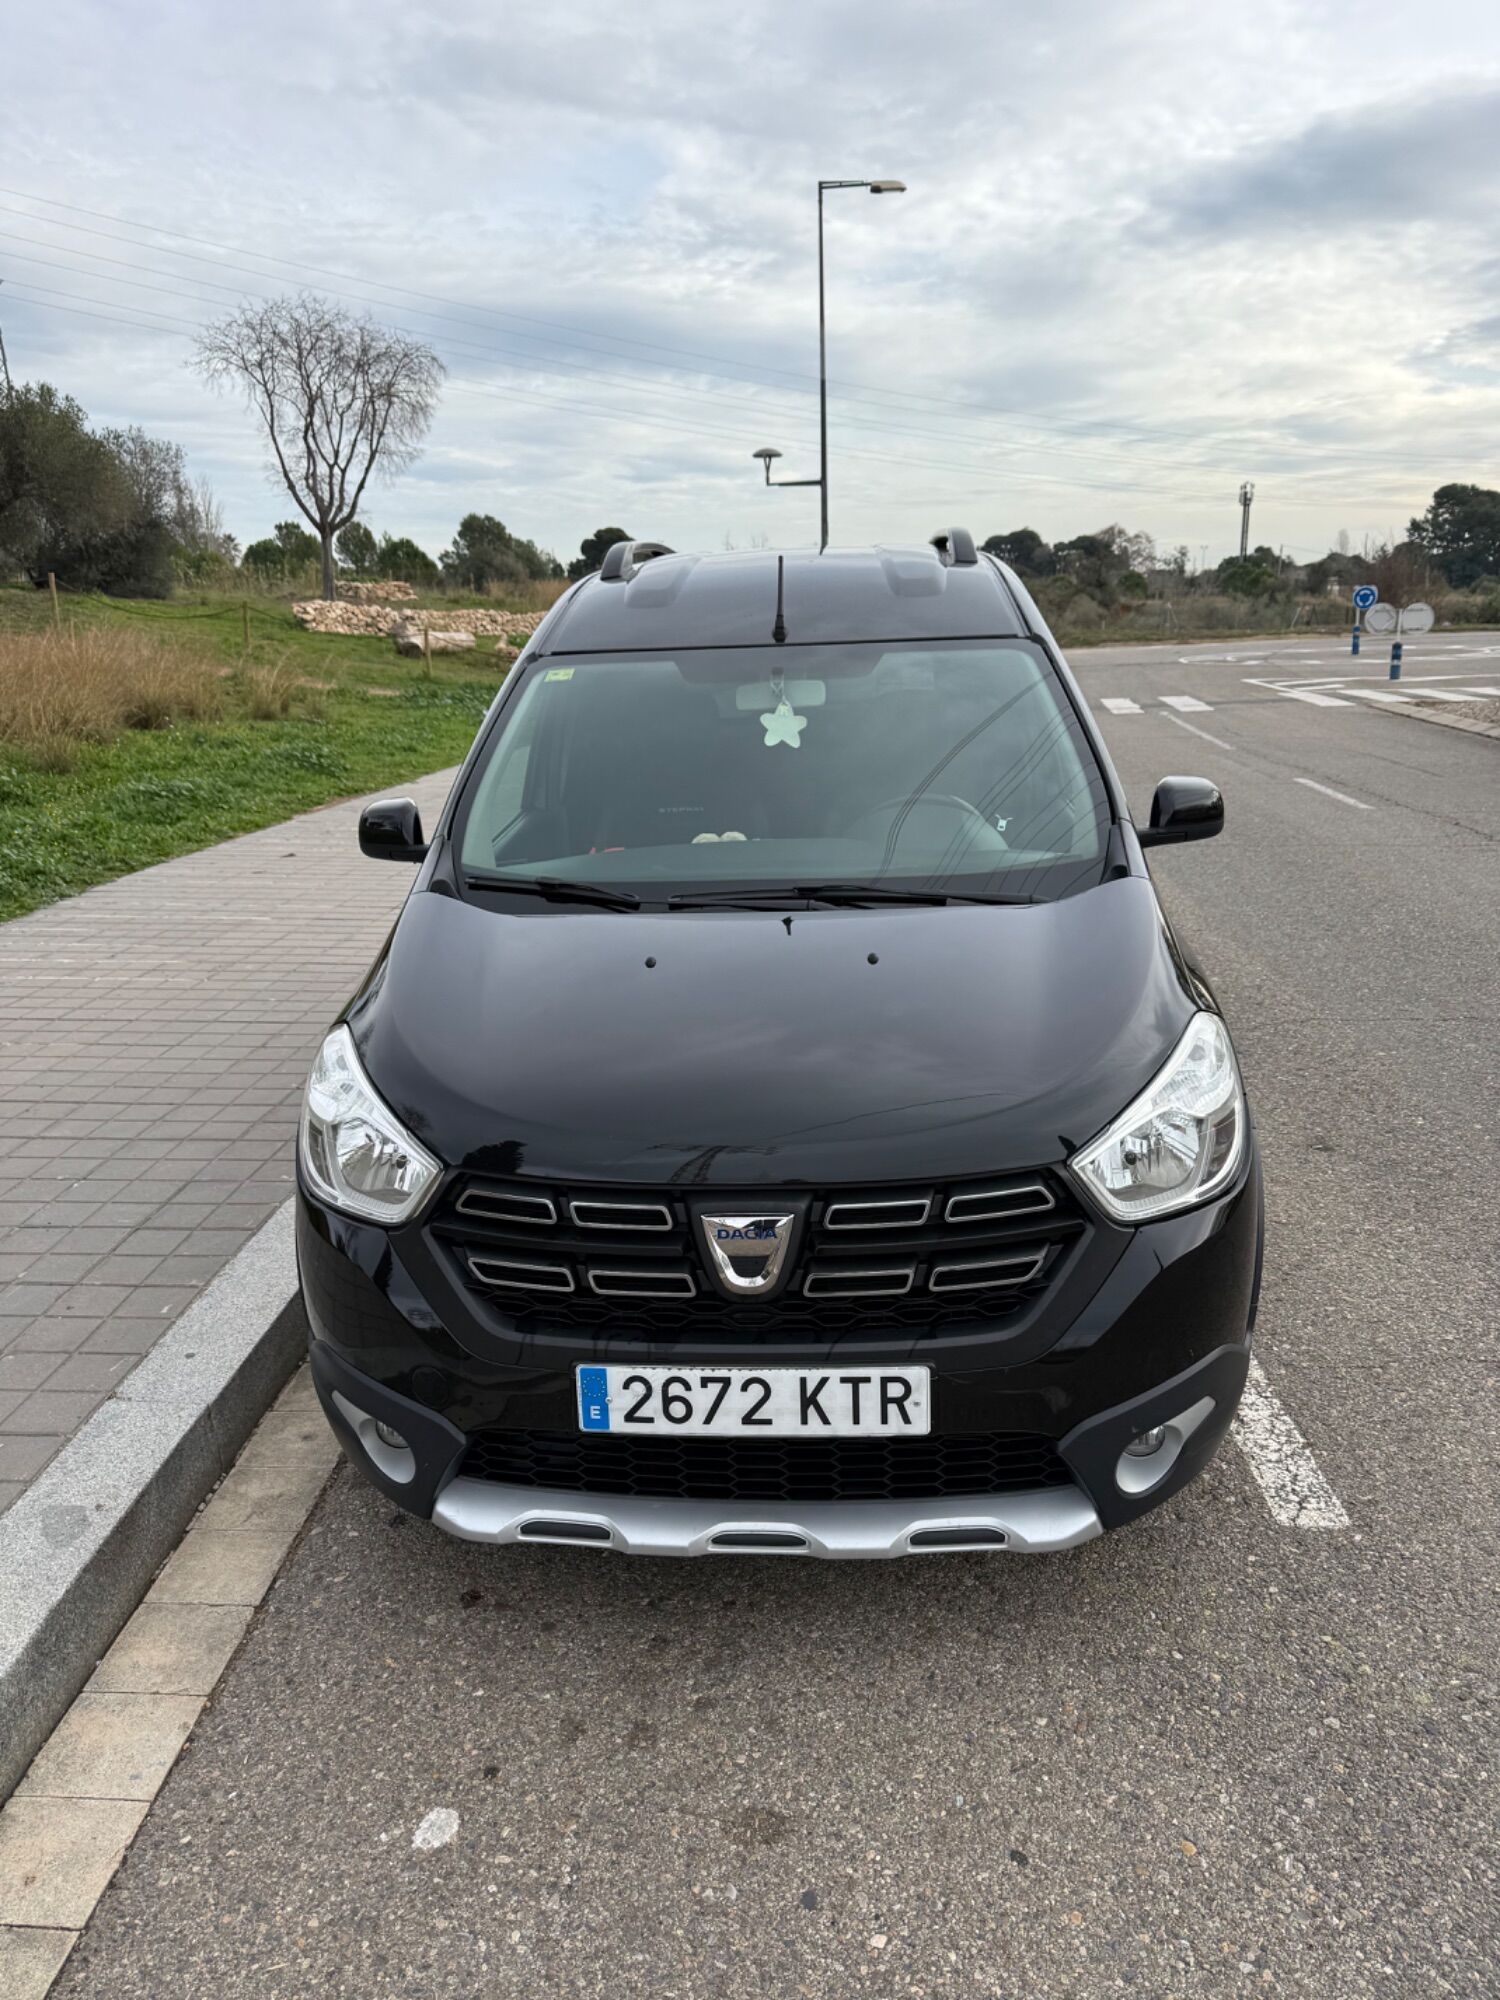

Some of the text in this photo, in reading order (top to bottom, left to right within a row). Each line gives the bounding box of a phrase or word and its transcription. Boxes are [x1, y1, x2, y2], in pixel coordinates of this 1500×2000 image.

[716, 1228, 778, 1240] DACIA
[621, 1375, 913, 1426] 2672 KTR
[590, 1405, 601, 1420] E
